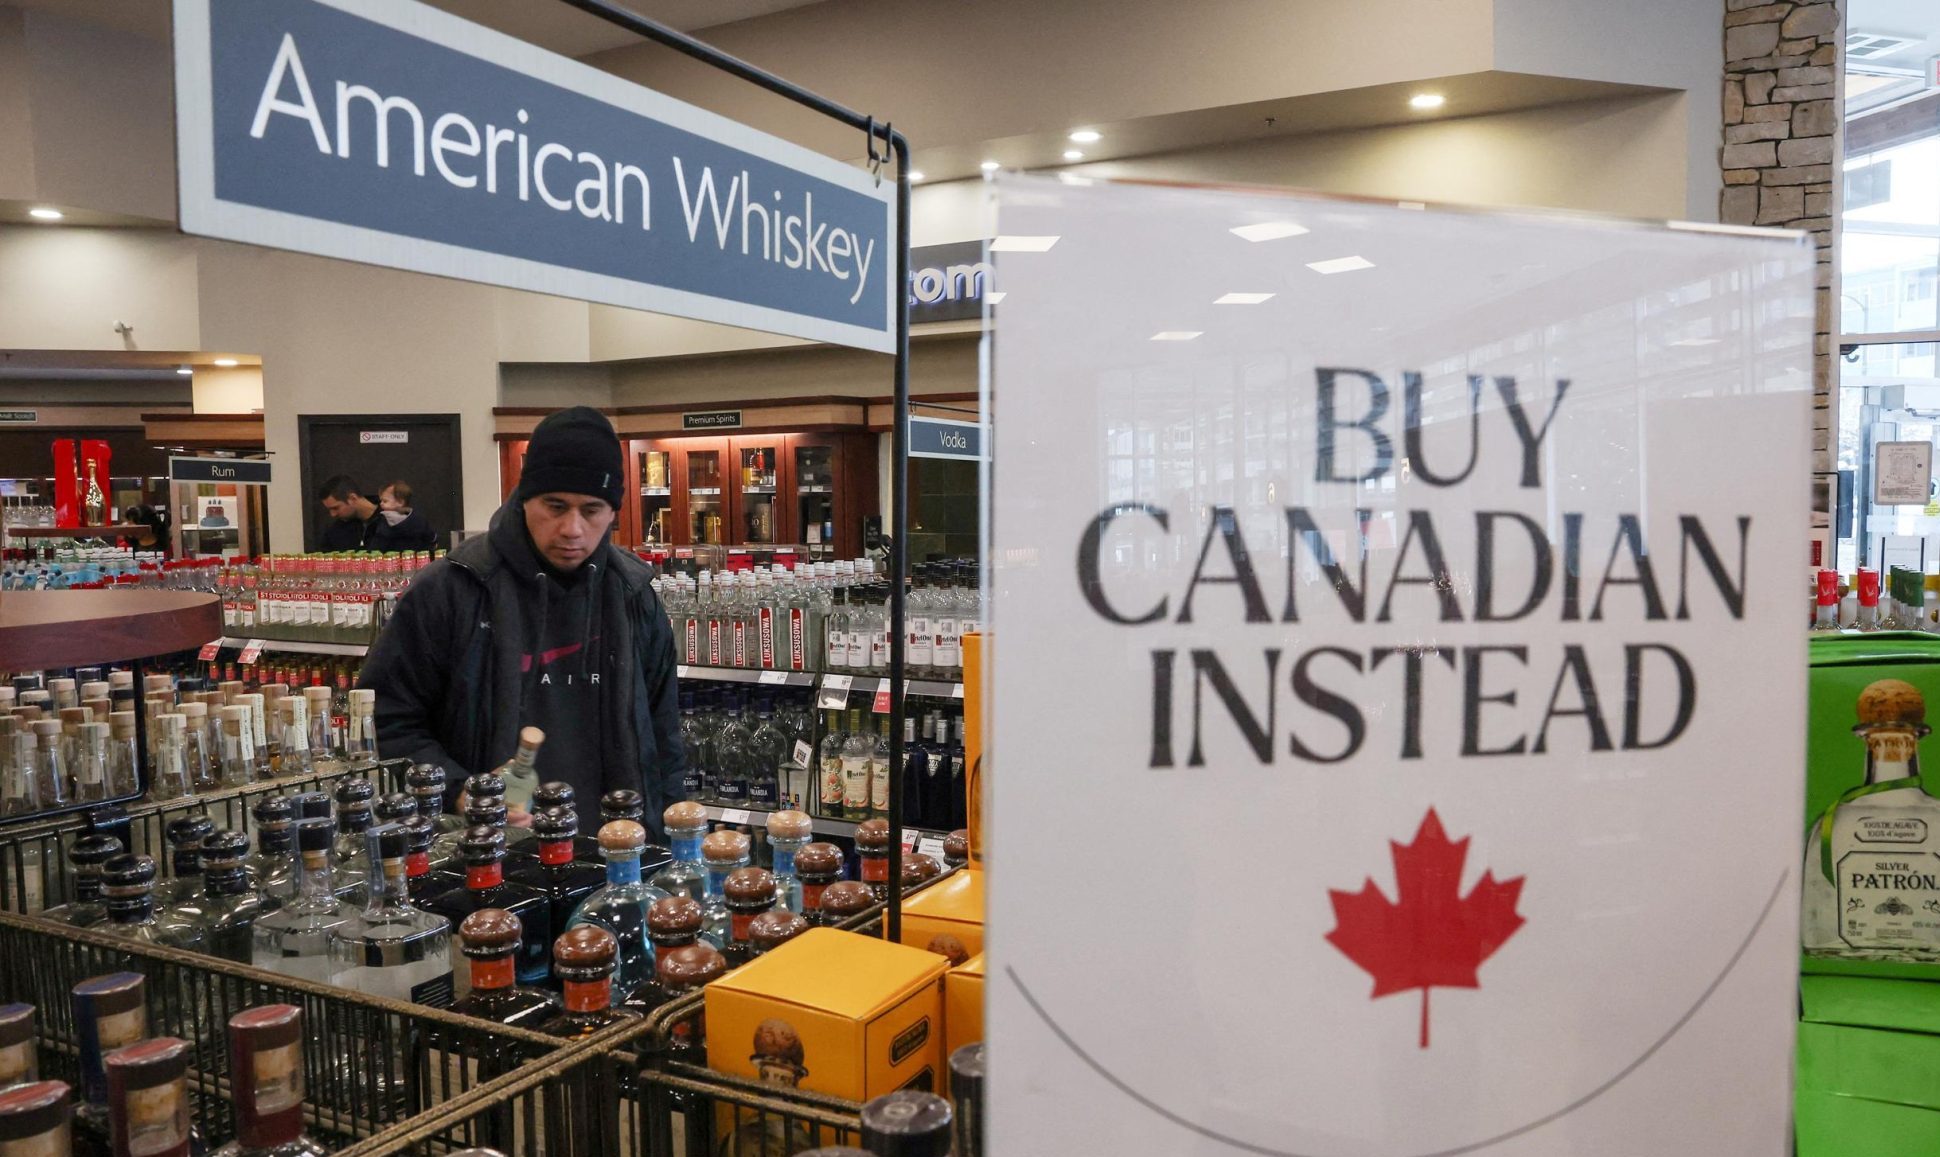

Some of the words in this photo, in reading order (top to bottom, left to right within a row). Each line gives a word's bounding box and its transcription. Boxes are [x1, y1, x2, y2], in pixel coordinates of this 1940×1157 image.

[250, 33, 651, 230] American
[673, 156, 874, 304] Whiskey
[910, 262, 995, 304] om
[689, 416, 715, 424] Premium
[716, 415, 736, 424] Spirits
[940, 431, 966, 448] Vodka
[1314, 366, 1571, 489] BUY
[211, 466, 235, 477] Rum
[1076, 503, 1751, 626] CANADIAN
[793, 618, 801, 664] LUKSUSOWA
[541, 673, 600, 685] AIR
[1148, 643, 1698, 769] INSTEAD
[1875, 862, 1909, 871] SILVER
